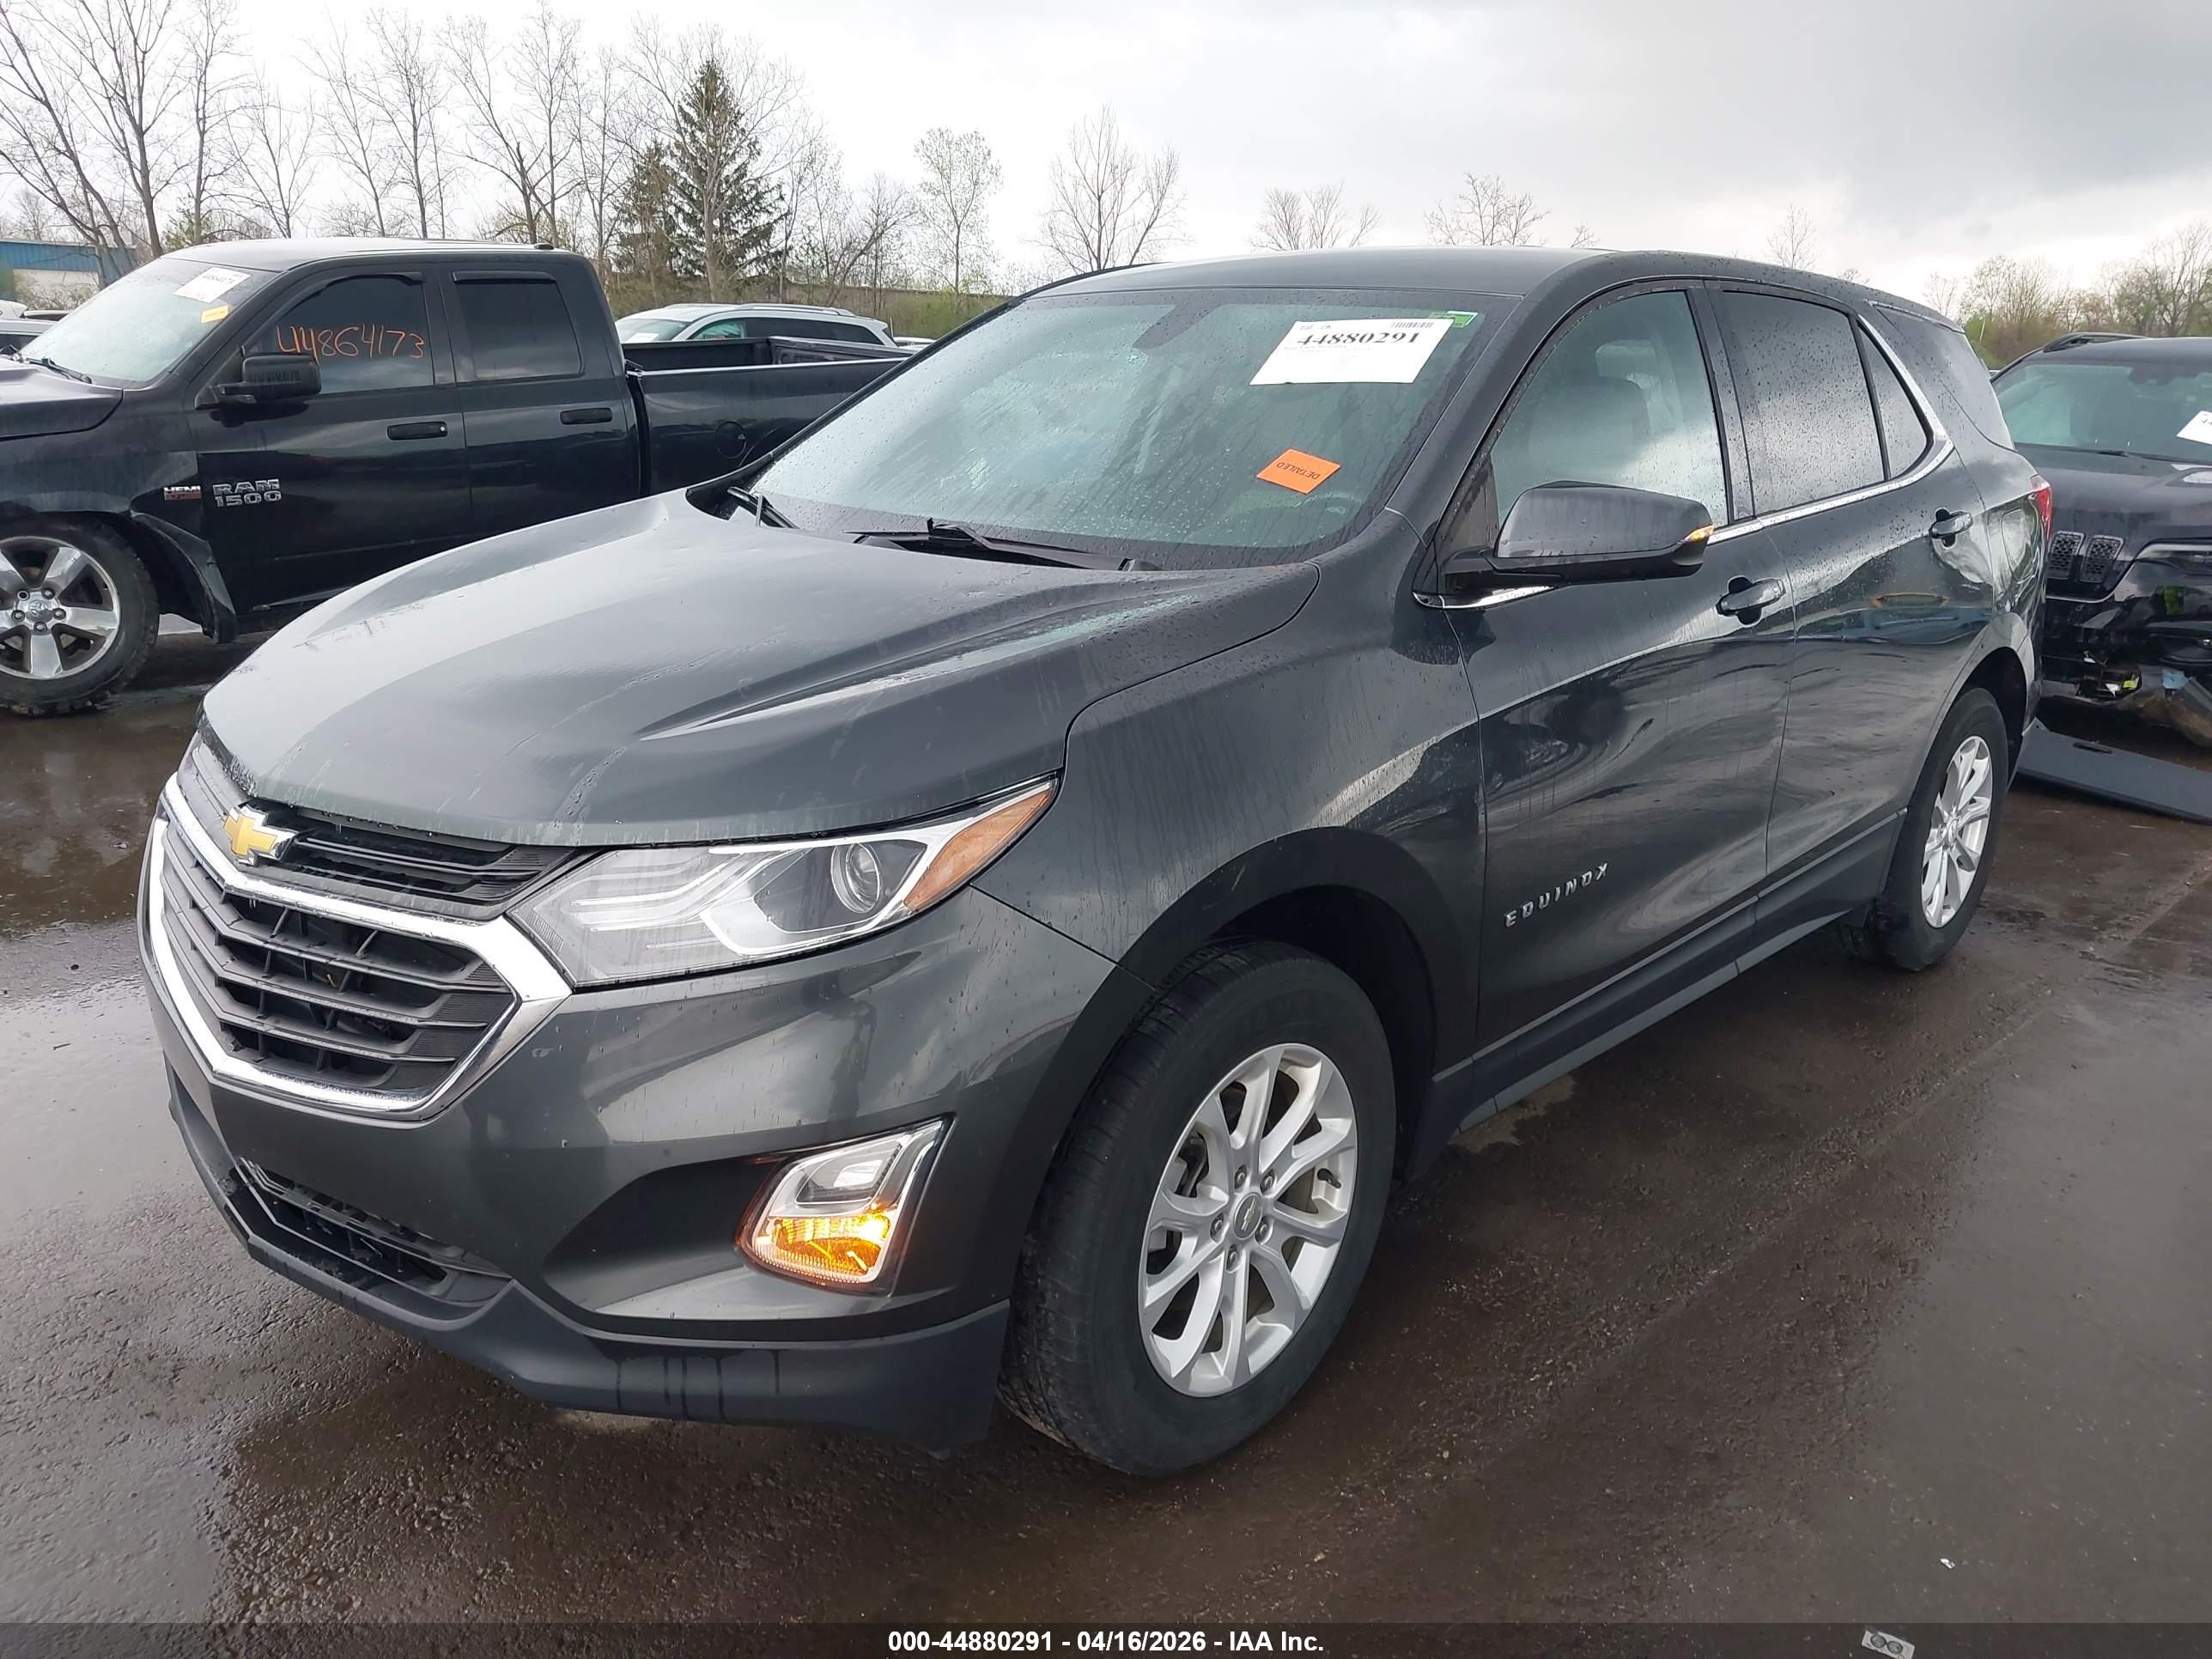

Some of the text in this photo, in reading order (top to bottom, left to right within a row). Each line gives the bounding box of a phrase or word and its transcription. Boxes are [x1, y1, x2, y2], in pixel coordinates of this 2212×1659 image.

[276, 323, 426, 365] 44864173
[1297, 331, 1420, 345] 44880291
[1276, 462, 1321, 480] DETAILED
[212, 478, 280, 495] RAM
[215, 490, 282, 507] 1500
[1505, 863, 1608, 927] EQUINOX
